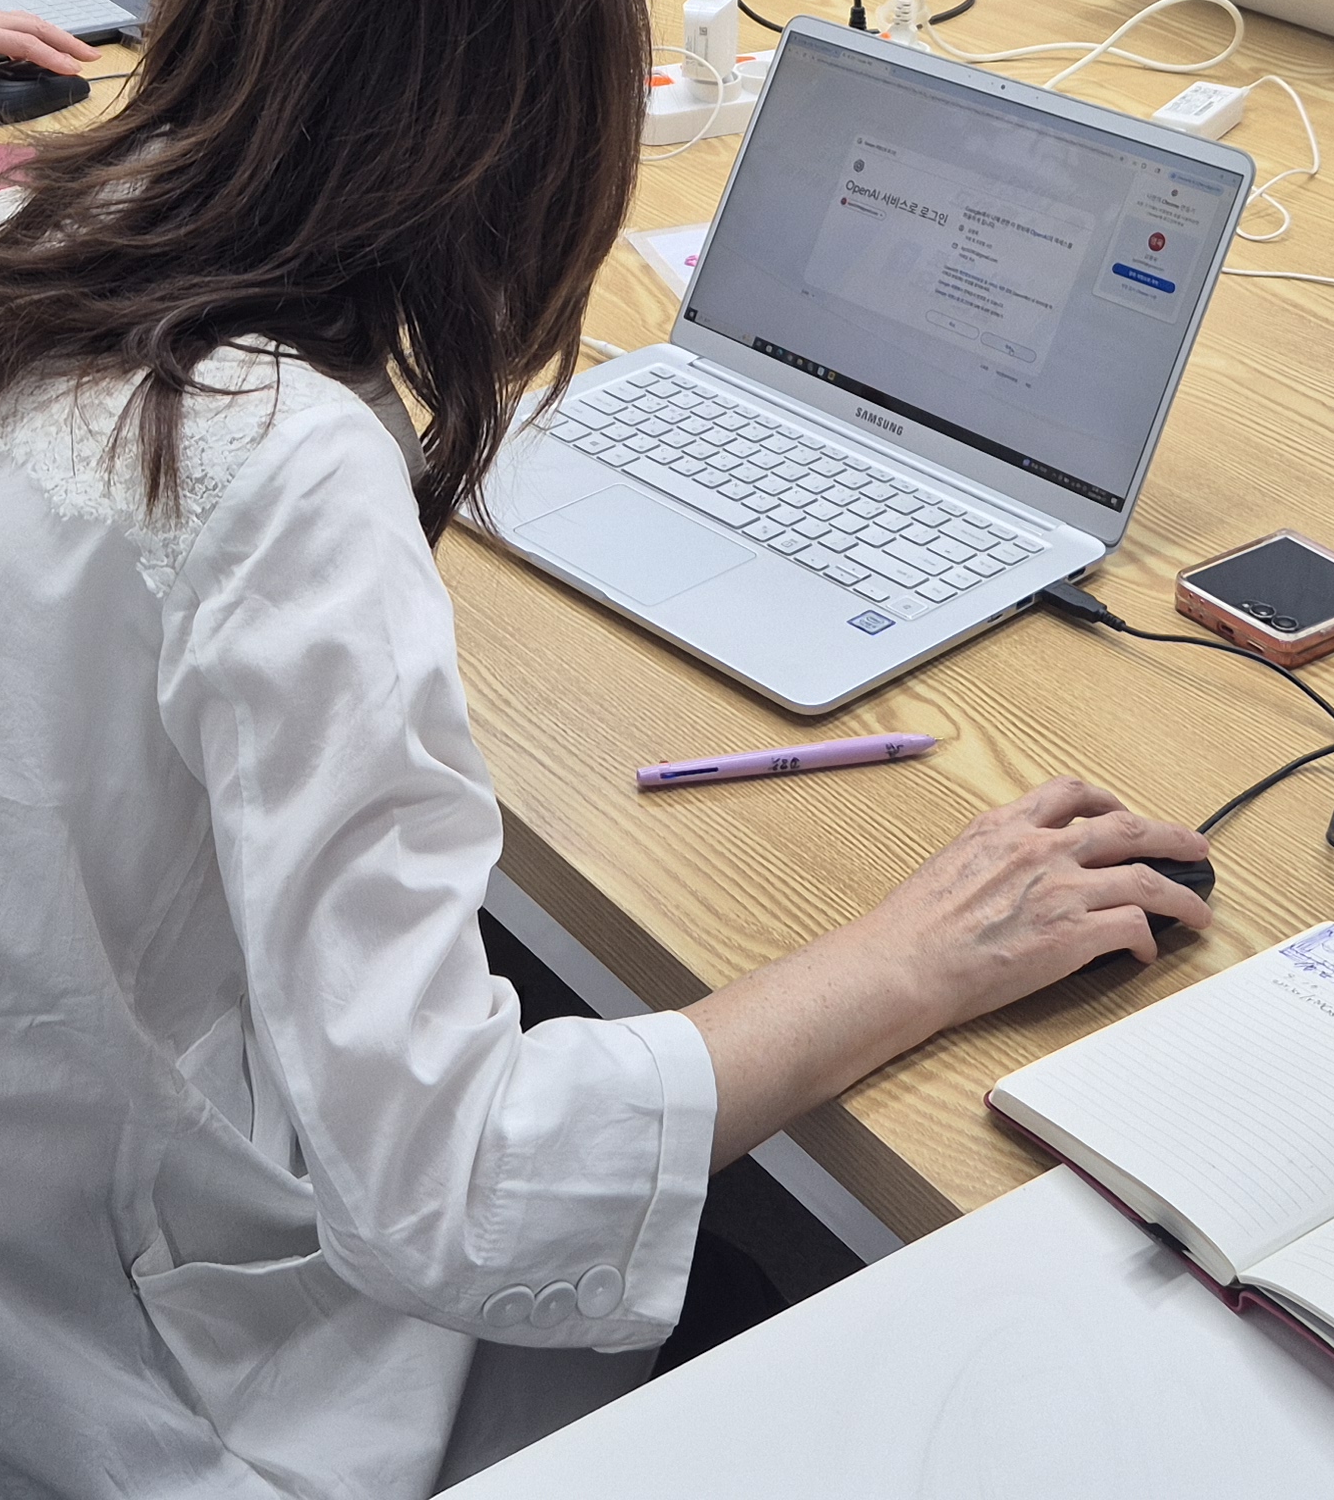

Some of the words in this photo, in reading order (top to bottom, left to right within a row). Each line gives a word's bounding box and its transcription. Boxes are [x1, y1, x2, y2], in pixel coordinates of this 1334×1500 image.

[845, 179, 881, 201] OpenAI
[881, 193, 918, 215] 서비스로
[919, 206, 949, 227] 로그인
[855, 406, 904, 437] SAMSUNG
